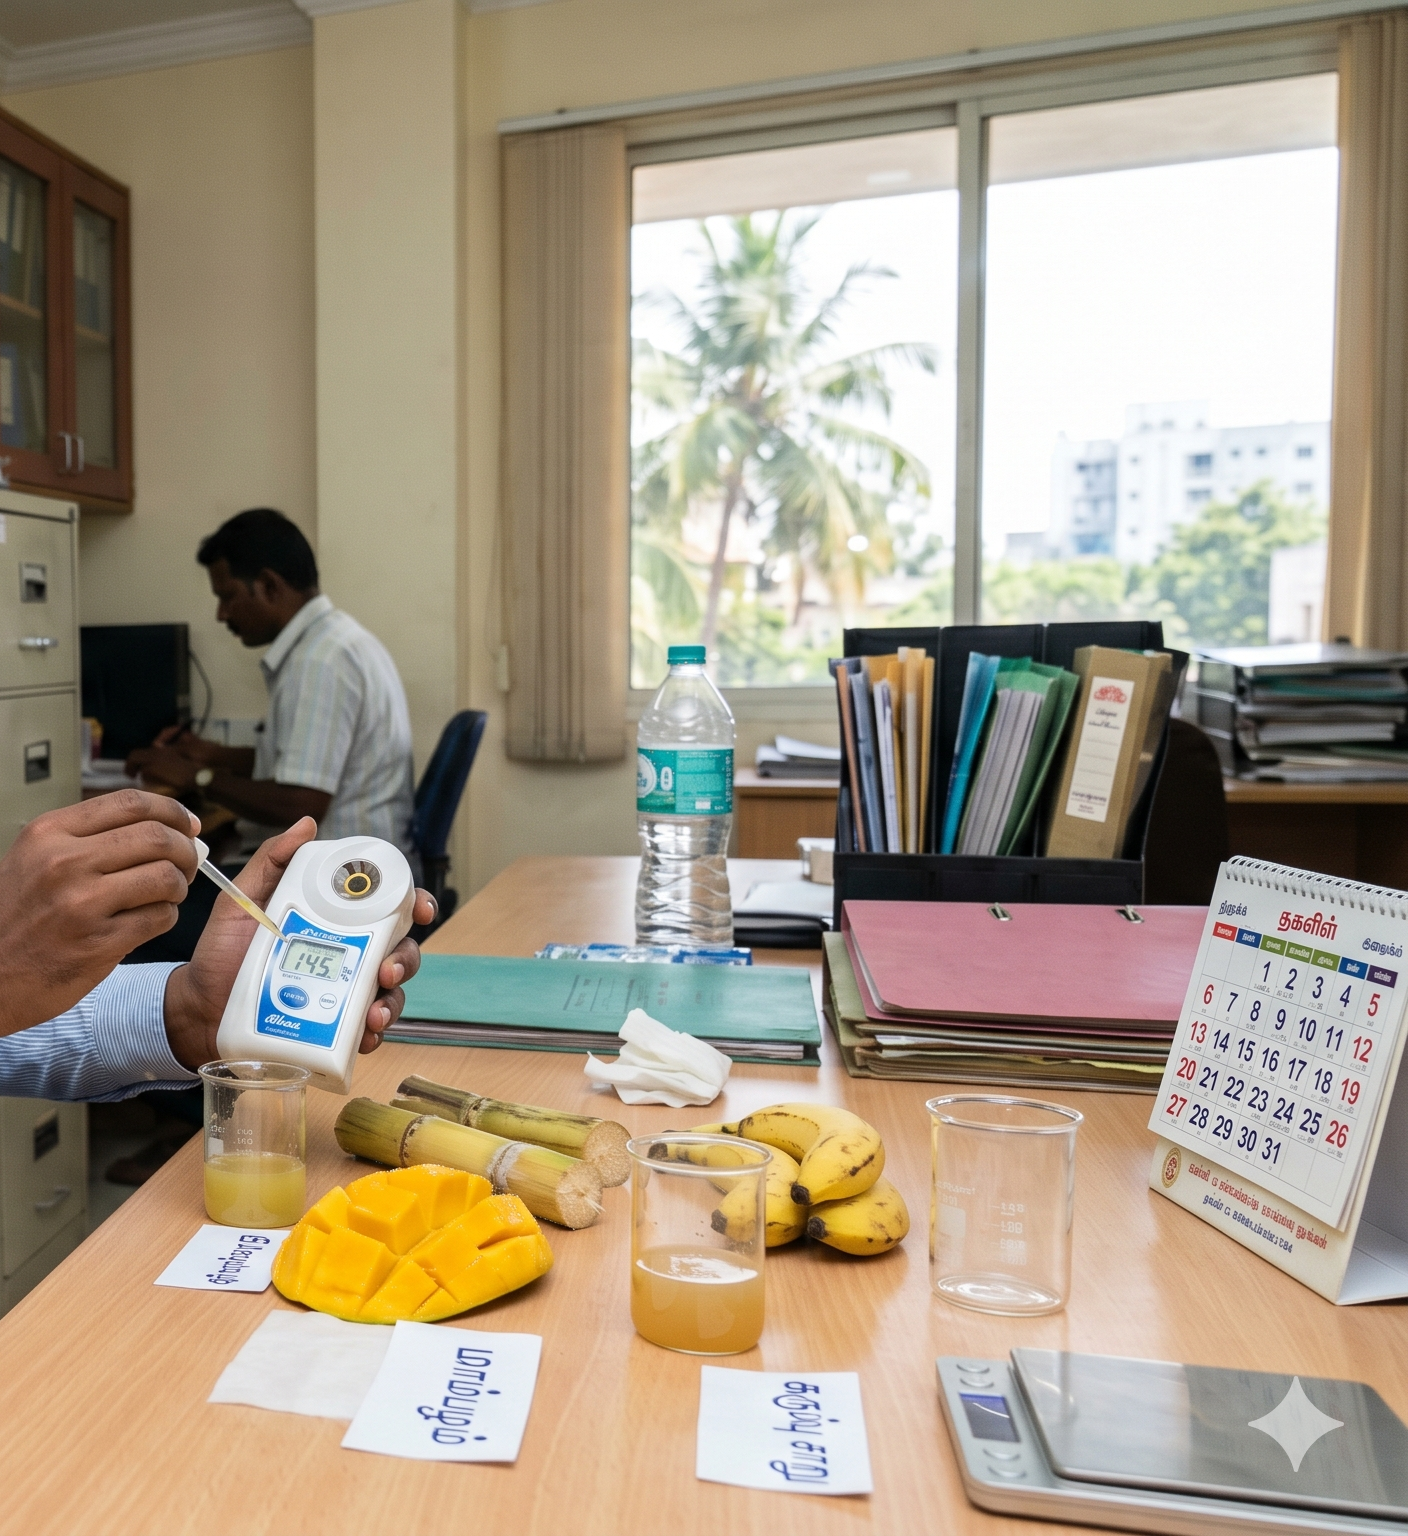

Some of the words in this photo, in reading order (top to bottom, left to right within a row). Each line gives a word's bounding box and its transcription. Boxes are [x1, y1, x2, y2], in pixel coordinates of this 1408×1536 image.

[1203, 984, 1215, 1005] 6
[1226, 991, 1239, 1013] 7
[1249, 1000, 1262, 1022] 8
[1274, 1008, 1287, 1031] 9
[1299, 1016, 1317, 1042] 10
[1325, 1025, 1344, 1052] 11
[1353, 1035, 1373, 1063] 12
[1263, 961, 1271, 983] 1
[1284, 968, 1298, 991] 2
[1312, 975, 1324, 999] 3
[1339, 984, 1352, 1008] 4
[1367, 993, 1381, 1017] 5
[1190, 1020, 1207, 1044] 13
[1213, 1029, 1231, 1053] 14
[1237, 1037, 1256, 1062] 15
[1261, 1047, 1280, 1072] 16
[1288, 1057, 1308, 1082] 17
[1314, 1067, 1333, 1095] 18
[1341, 1078, 1361, 1105] 19
[1165, 1093, 1188, 1118] 27
[1188, 1103, 1210, 1129] 28
[1212, 1114, 1234, 1141] 29
[1237, 1125, 1258, 1152] 30
[1261, 1137, 1282, 1165] 31
[1176, 1056, 1197, 1081] 20
[1198, 1066, 1219, 1091] 21
[1223, 1075, 1245, 1102] 22
[1247, 1086, 1269, 1113] 23
[1272, 1097, 1296, 1125] 24
[1298, 1108, 1323, 1136] 25
[1325, 1119, 1349, 1149] 26
[770, 1440, 830, 1484] சாறு
